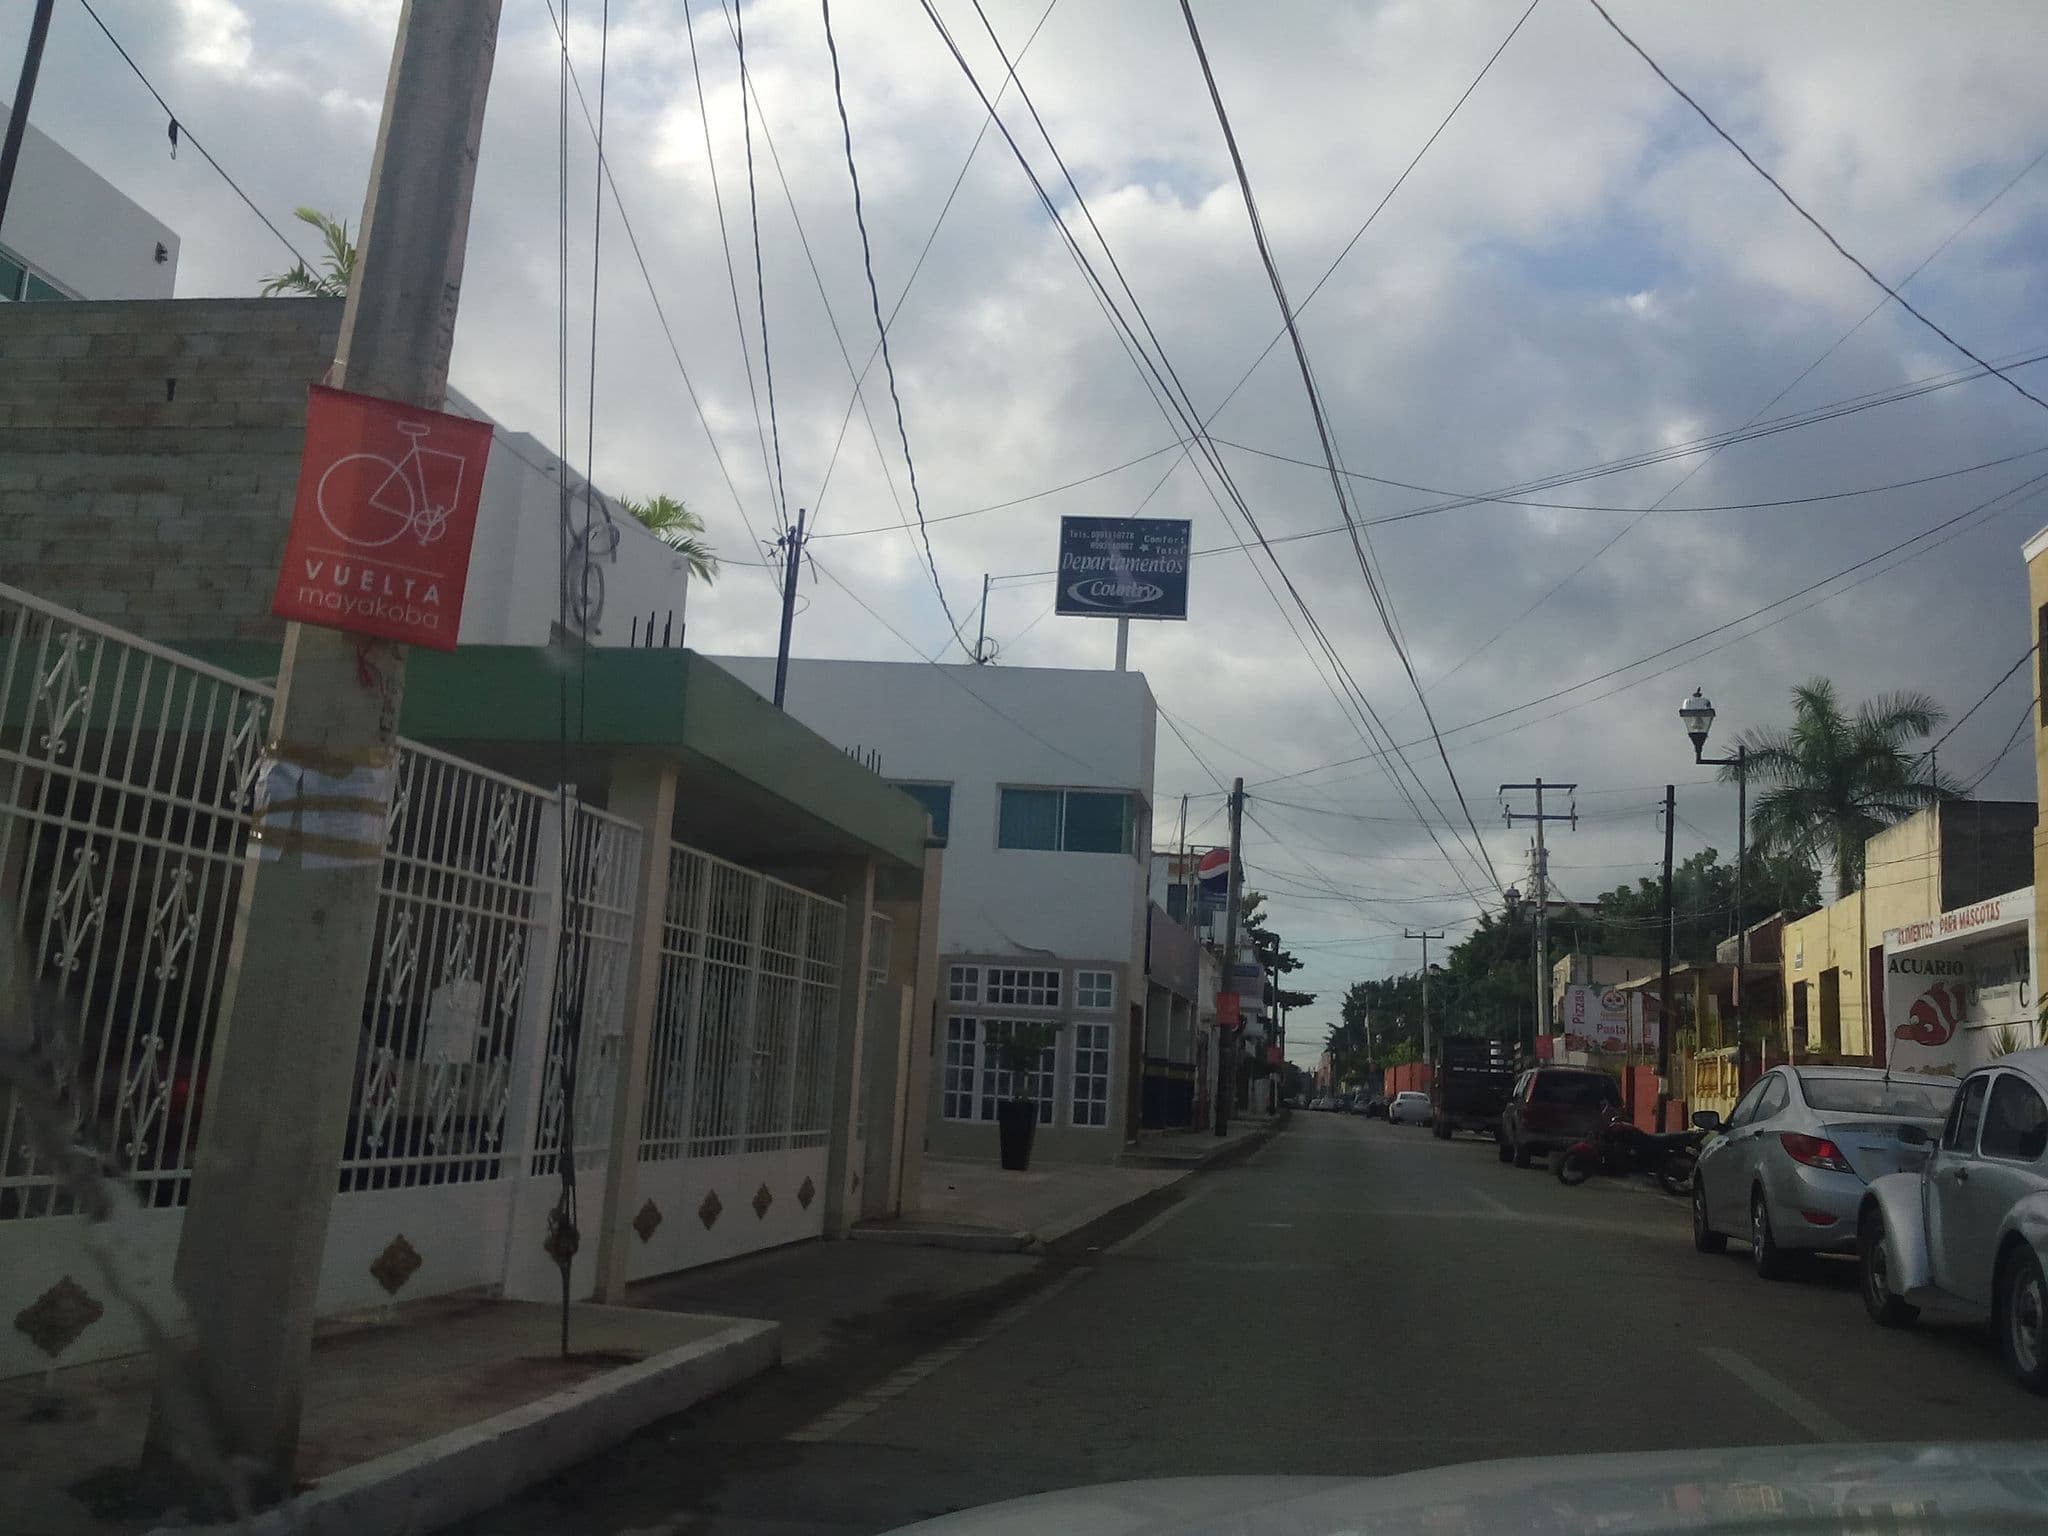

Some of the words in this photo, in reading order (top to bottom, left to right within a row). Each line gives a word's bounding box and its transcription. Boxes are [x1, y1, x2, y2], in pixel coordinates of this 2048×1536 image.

[1062, 552, 1183, 573] Departamentos
[305, 559, 440, 606] VUELTA
[1091, 581, 1155, 600] Country
[299, 586, 439, 629] mayakoba
[1939, 914, 1957, 935] PARA
[1959, 900, 2000, 929] MASCOTAS
[1888, 958, 1964, 975] ACUARIO
[1572, 990, 1584, 1024] Pizzas
